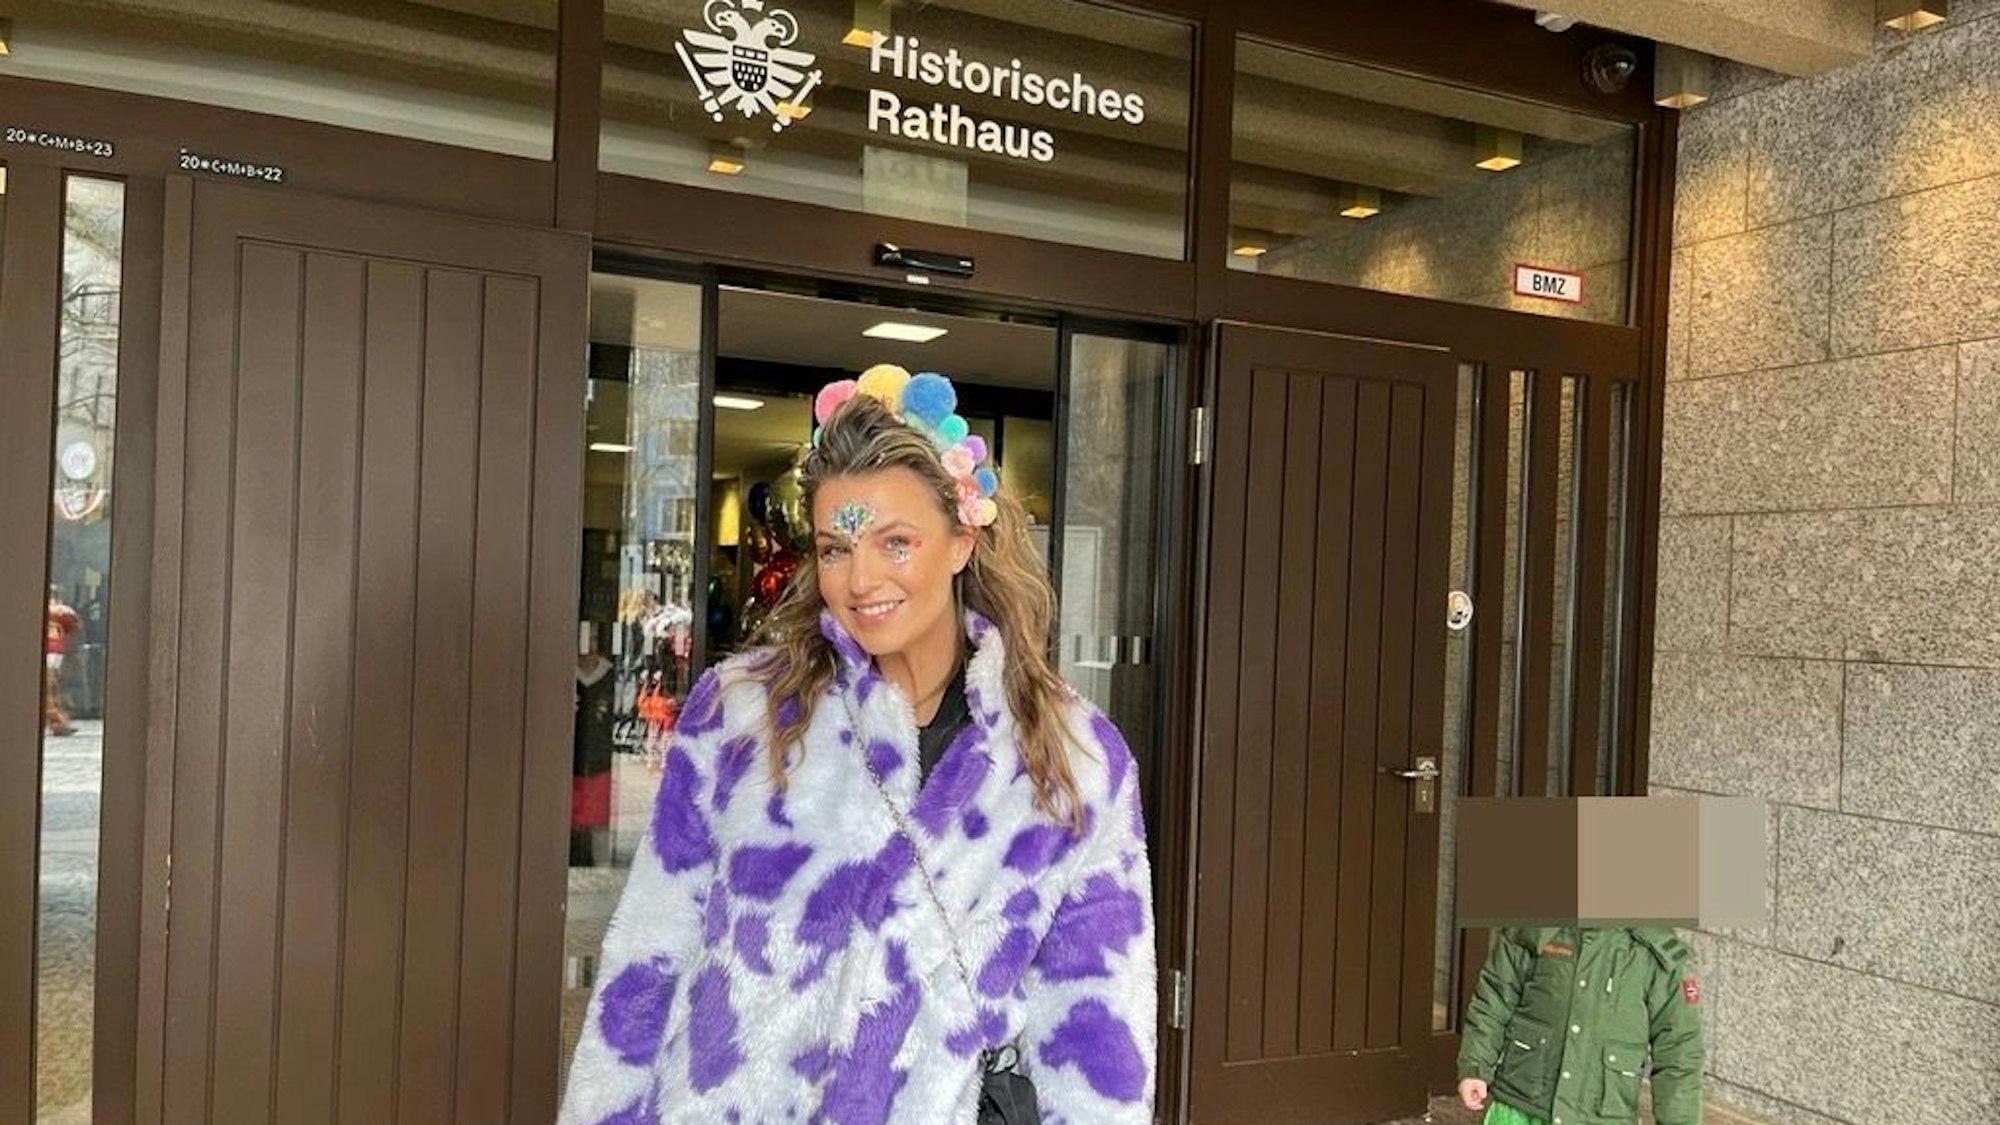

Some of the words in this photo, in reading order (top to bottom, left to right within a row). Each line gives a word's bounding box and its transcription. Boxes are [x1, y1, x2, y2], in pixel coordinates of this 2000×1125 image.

[868, 29, 1146, 126] Historisches
[867, 88, 1056, 162] Rathaus
[1532, 273, 1566, 296] BMZ
